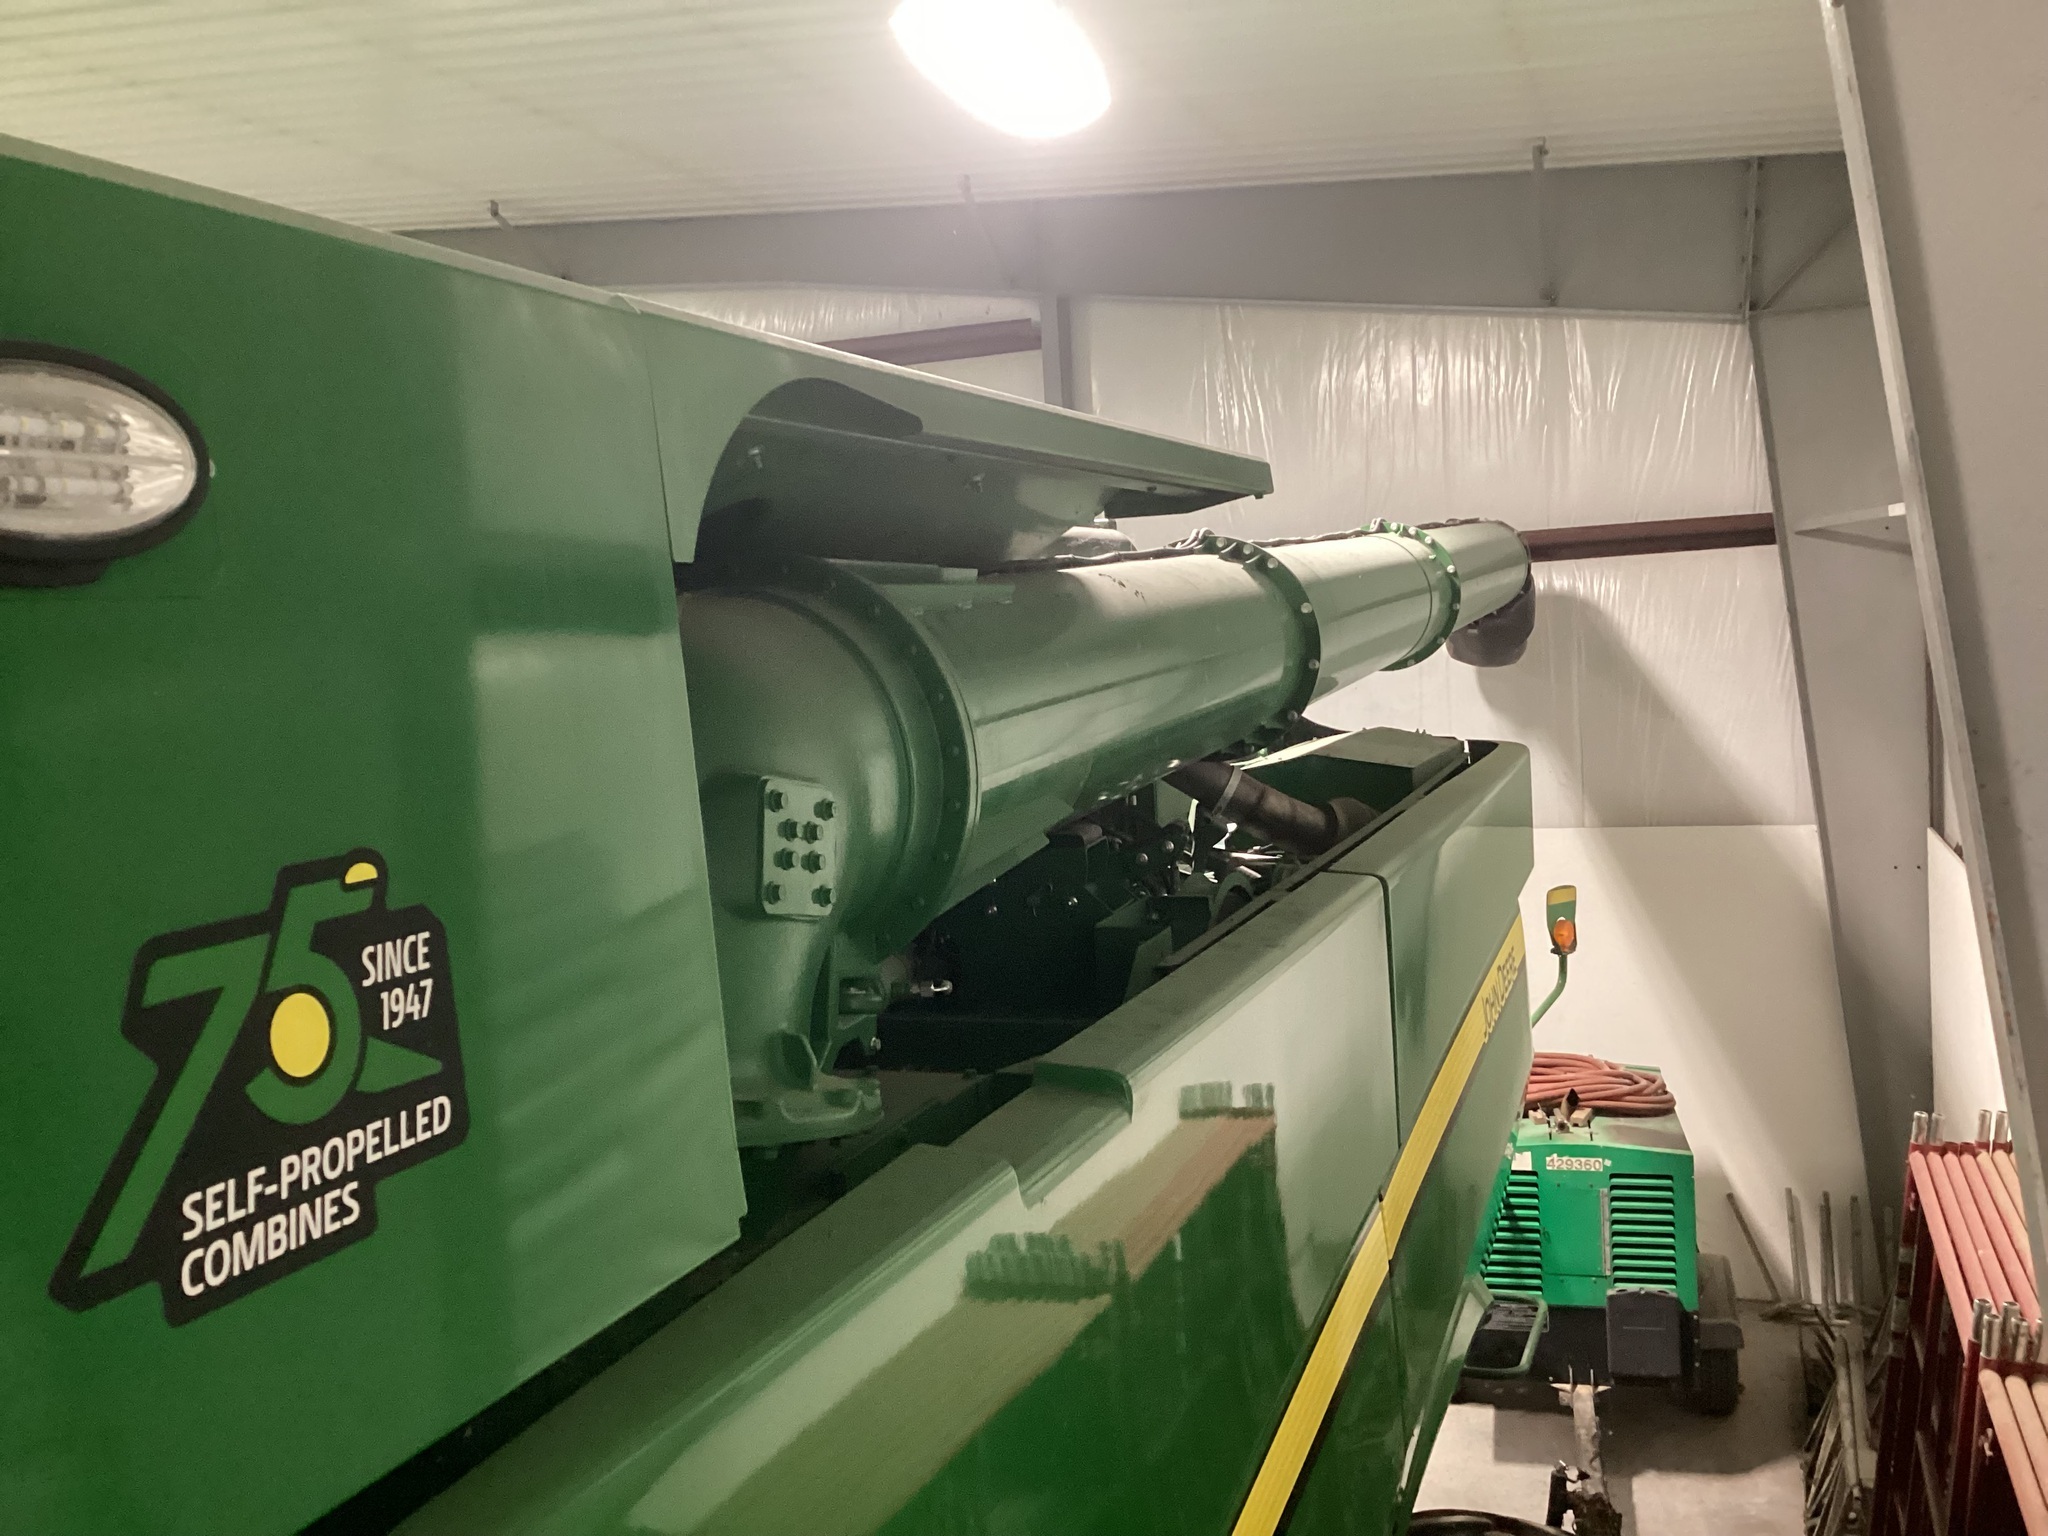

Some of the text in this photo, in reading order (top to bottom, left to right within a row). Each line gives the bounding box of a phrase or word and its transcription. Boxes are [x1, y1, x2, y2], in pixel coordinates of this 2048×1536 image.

[361, 931, 431, 987] SINCE
[380, 979, 434, 1030] 1947
[181, 1095, 452, 1241] SELF-PROPELLED
[1546, 1157, 1602, 1171] 429360
[181, 1181, 361, 1297] COMBINES
